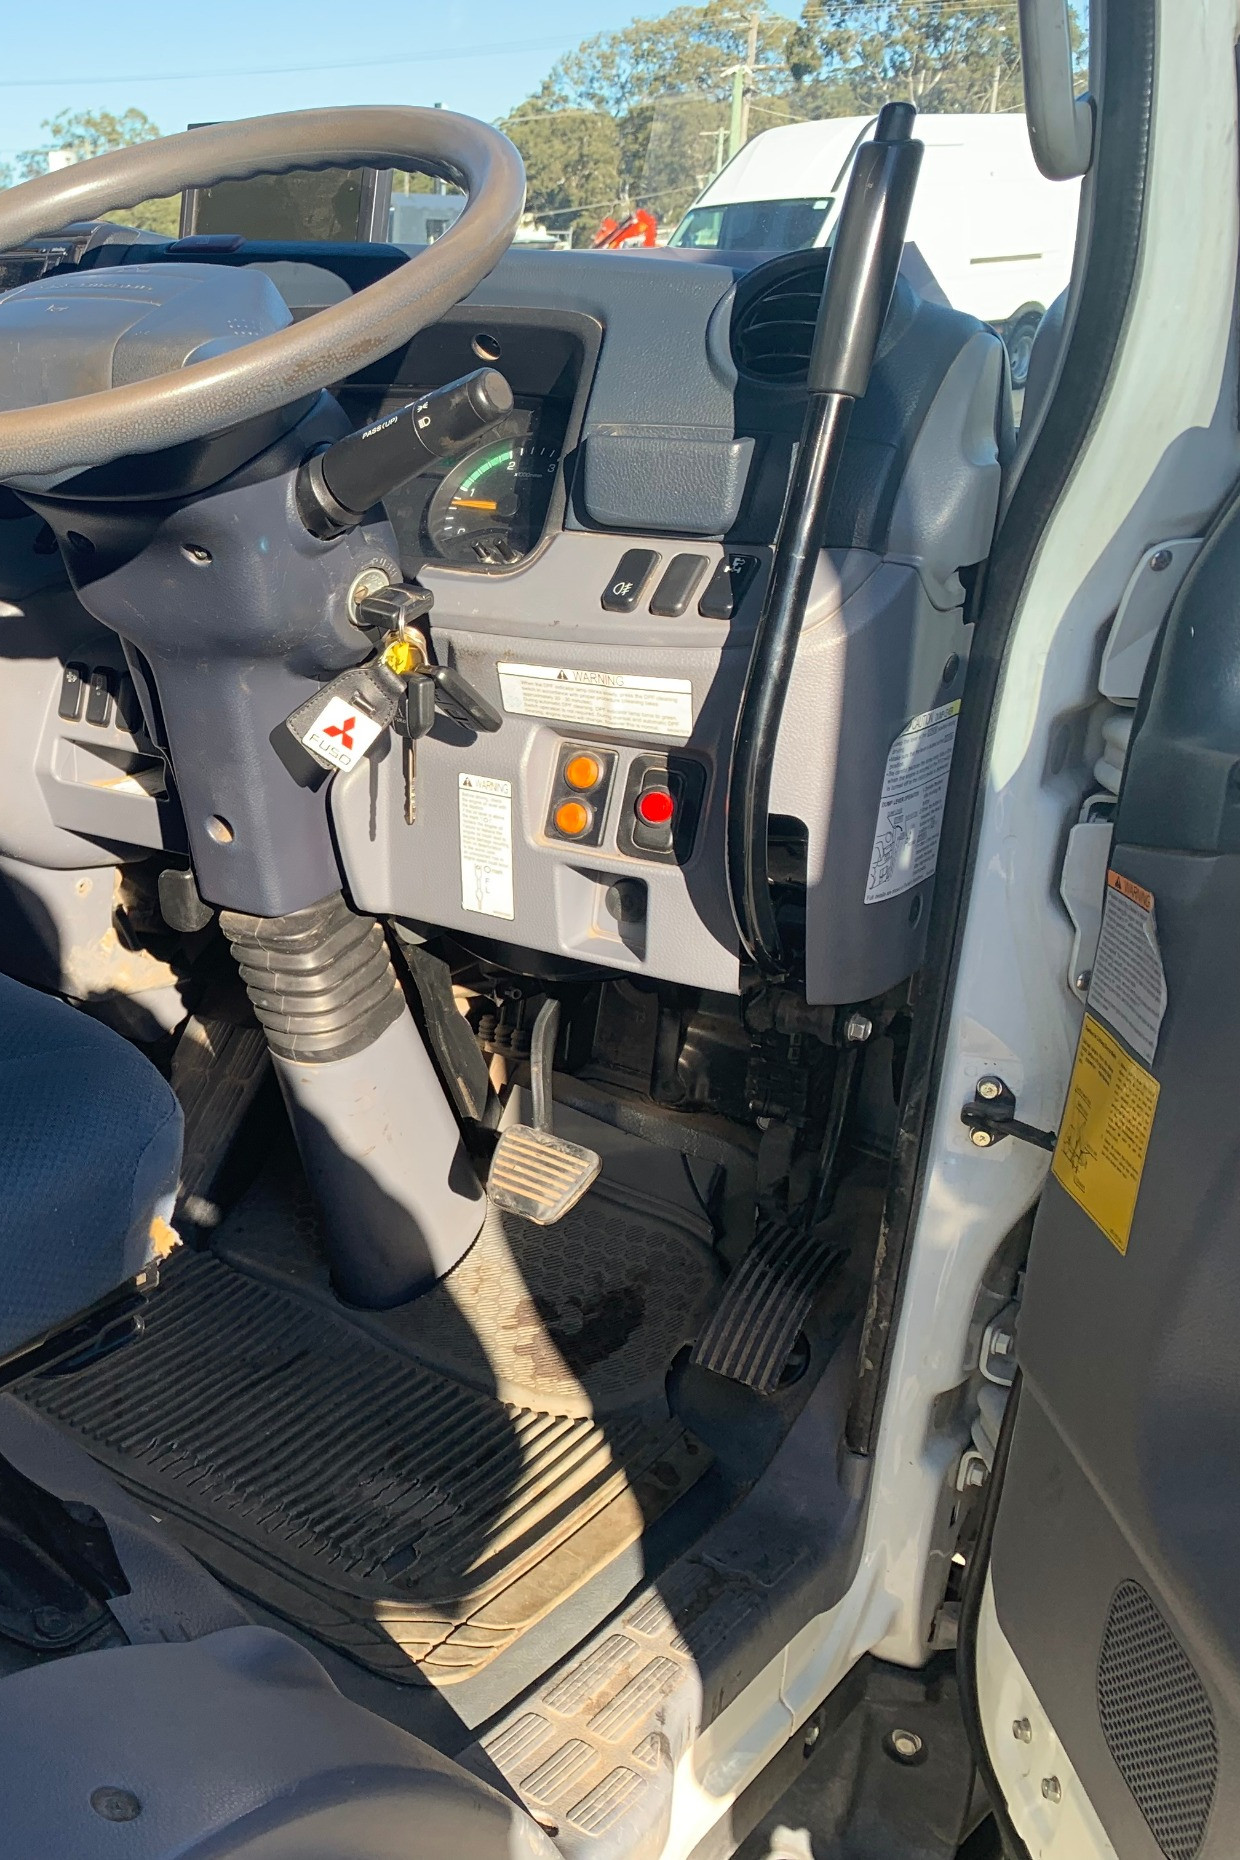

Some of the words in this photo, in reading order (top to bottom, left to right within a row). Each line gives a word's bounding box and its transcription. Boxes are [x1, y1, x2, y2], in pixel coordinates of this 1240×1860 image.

[362, 416, 398, 439] PASS(UP)
[507, 461, 516, 470] 2
[547, 463, 556, 473] 3
[572, 671, 625, 687] WARNING
[309, 733, 352, 766] FUSO
[475, 780, 509, 794] WARNING
